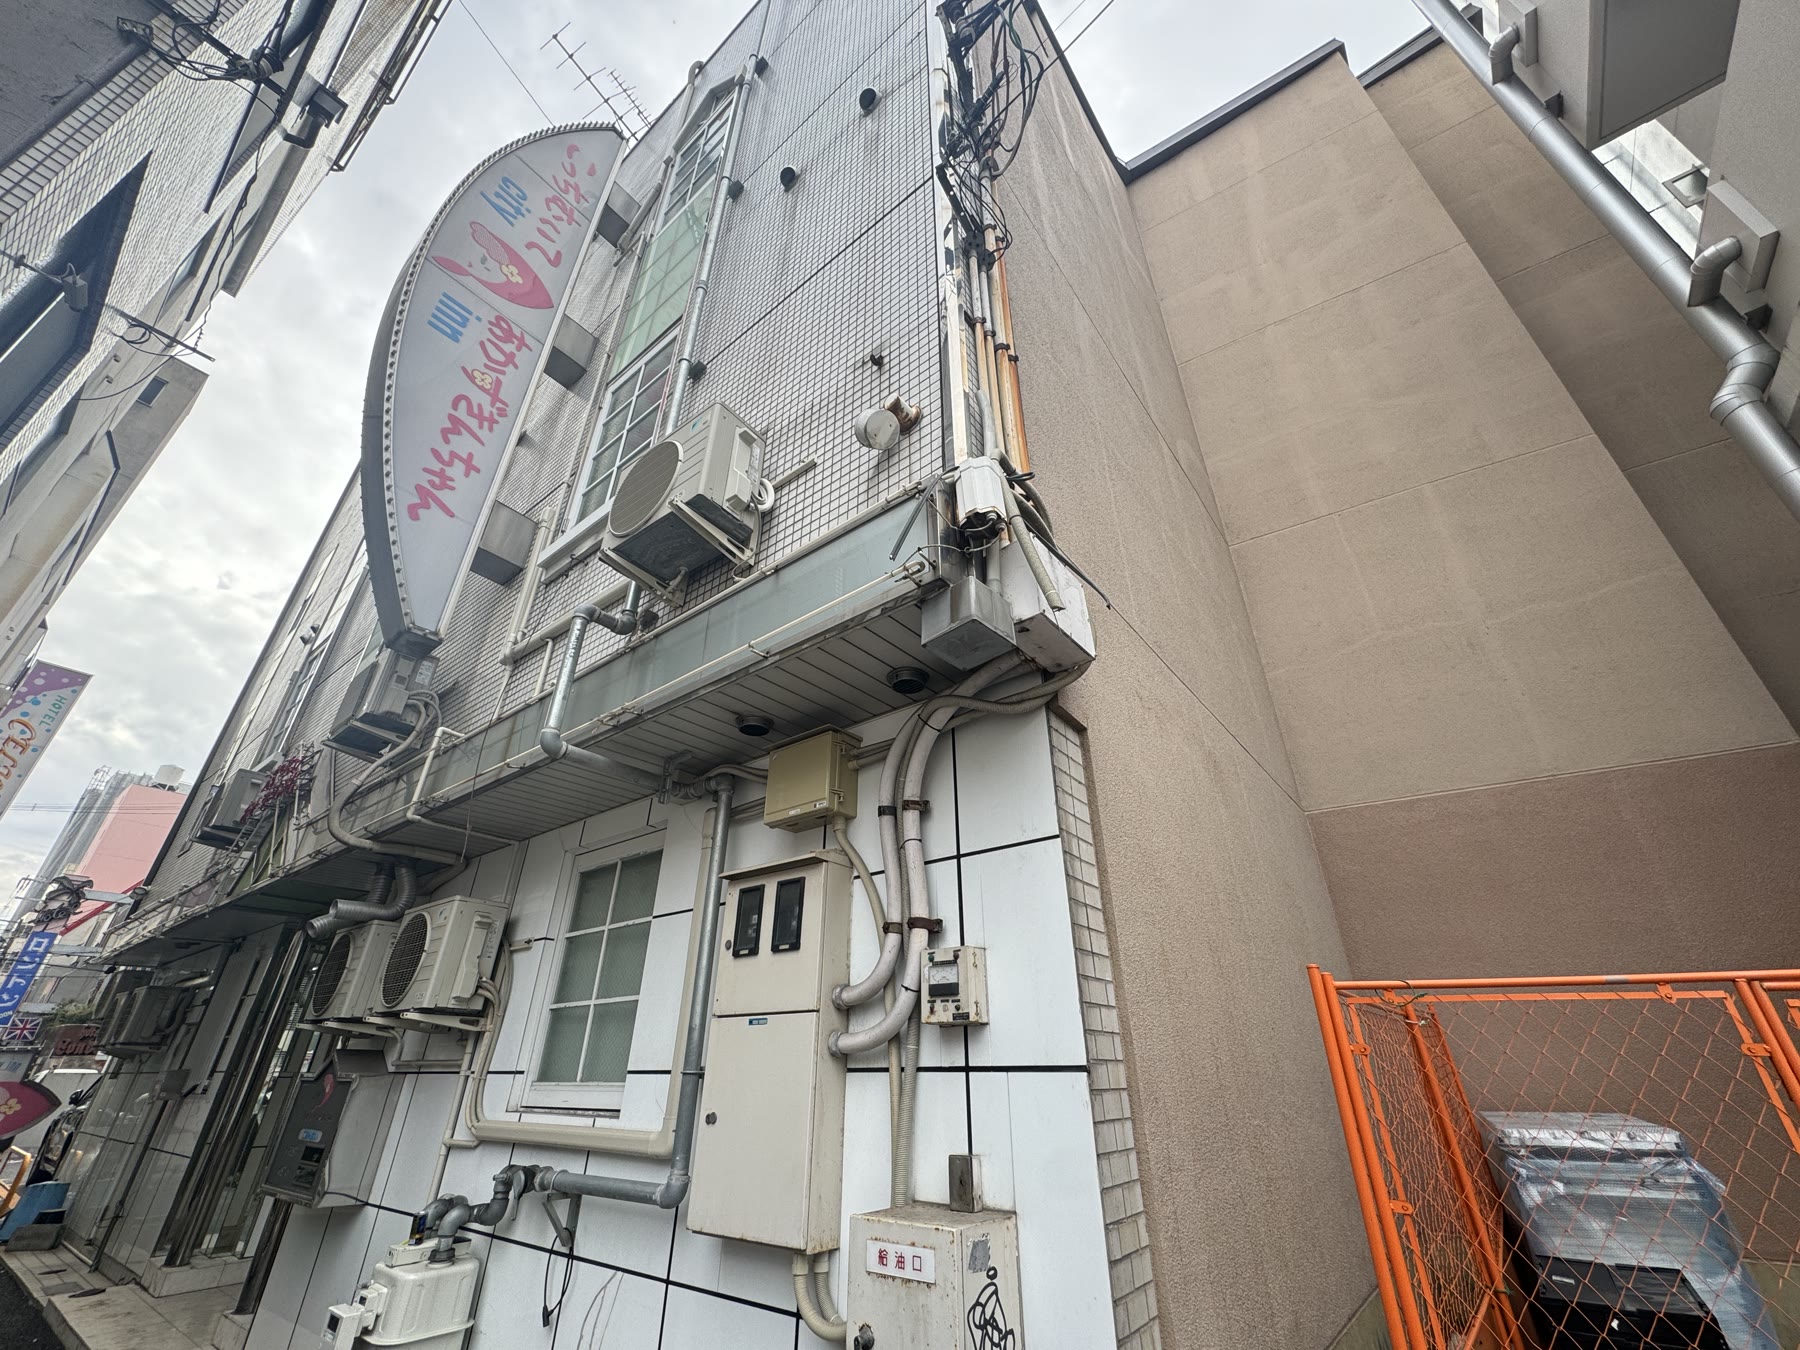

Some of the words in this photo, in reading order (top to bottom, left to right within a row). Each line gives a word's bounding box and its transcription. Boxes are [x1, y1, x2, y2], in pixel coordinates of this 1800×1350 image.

[480, 175, 532, 227] city
[525, 143, 599, 268] こっちむいて
[426, 291, 483, 344] inn
[406, 314, 534, 521] あかずきんちゃん
[38, 694, 68, 728] HOTEL
[878, 1247, 922, 1273] 給油口
